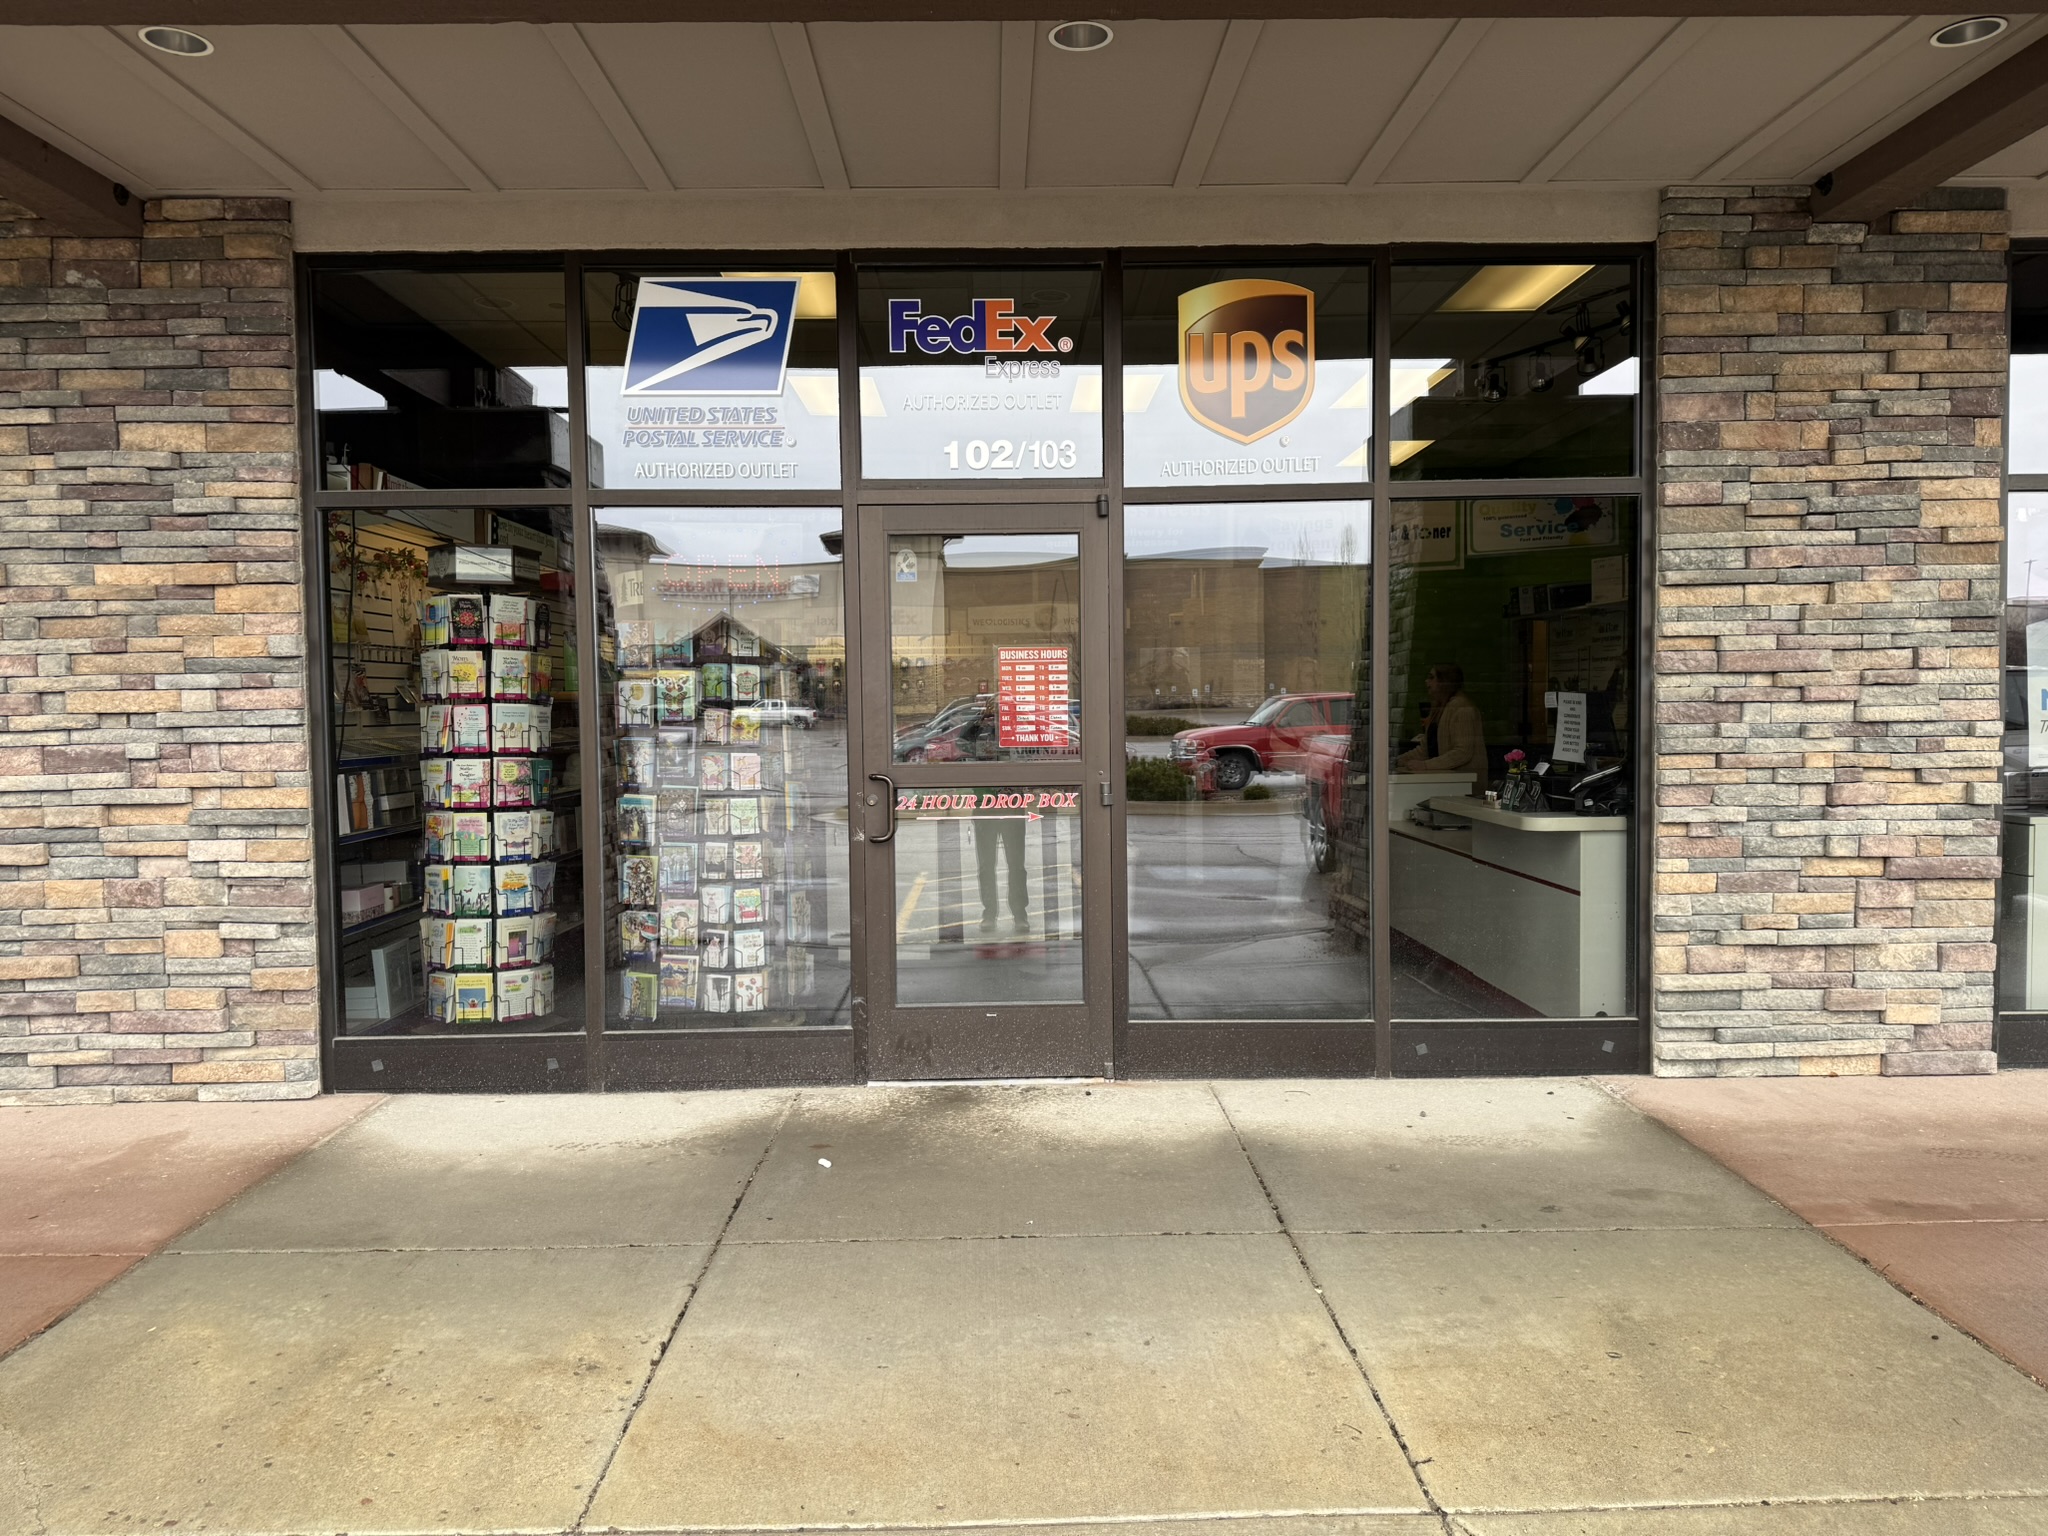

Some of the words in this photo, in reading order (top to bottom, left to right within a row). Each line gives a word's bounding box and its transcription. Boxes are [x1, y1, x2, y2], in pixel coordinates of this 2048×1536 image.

[888, 297, 1058, 355] FedEx
[984, 355, 1061, 381] Express
[1187, 328, 1307, 419] ups
[902, 393, 1000, 412] AUTHORIZED
[1003, 392, 1062, 411] OUTLET
[627, 406, 703, 425] UNITED
[705, 405, 778, 425] STATES
[622, 429, 698, 448] POSTAL
[700, 429, 784, 448] SERVICE
[943, 439, 1077, 470] 102/103
[634, 461, 736, 480] AUTHORIZED
[738, 461, 799, 479] OUTLET
[1160, 457, 1259, 478] AUTHORIZED
[1261, 455, 1321, 474] OUTLET
[1479, 502, 1537, 518] Quality
[1499, 519, 1581, 539] Service
[663, 553, 780, 588] OPEN
[1000, 650, 1039, 660] BUSINESS
[1040, 649, 1068, 659] HOURS
[1015, 734, 1039, 742] THANK
[1040, 733, 1054, 742] YOU
[895, 796, 918, 811] 24
[922, 794, 977, 811] HOUR
[979, 793, 1035, 809] DROP
[1037, 792, 1079, 808] BOX
